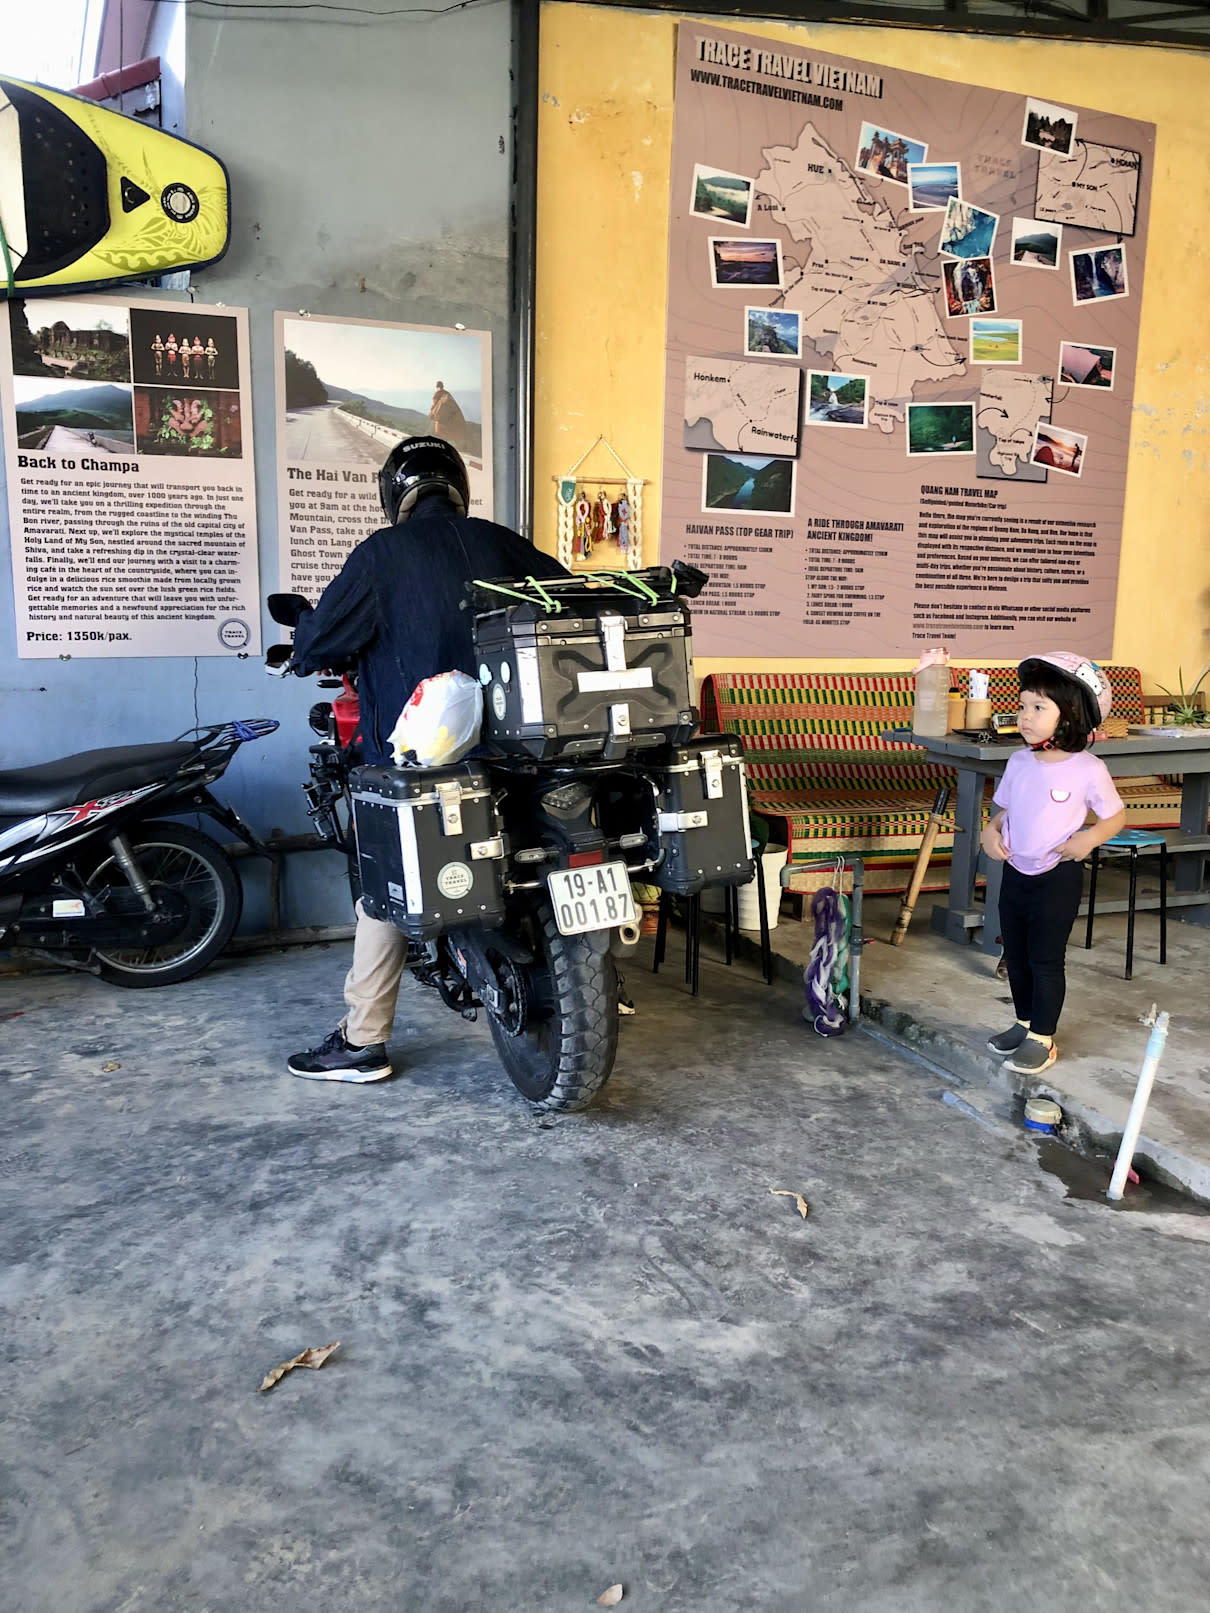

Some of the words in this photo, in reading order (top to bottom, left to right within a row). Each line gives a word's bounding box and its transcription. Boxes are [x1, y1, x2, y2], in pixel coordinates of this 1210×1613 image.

[695, 36, 750, 70] TRACE
[751, 48, 812, 83] TRAVEL
[810, 62, 883, 99] VIETNAM
[691, 69, 843, 111] WWW.TRACETRAVELVIETNAM.COM
[808, 164, 824, 173] HUE
[694, 372, 726, 384] Honkem
[403, 442, 445, 452] SUZUKI
[18, 456, 56, 469] Back
[61, 459, 76, 470] to
[81, 458, 139, 474] Champa
[287, 467, 312, 480] The
[316, 469, 338, 481] Hai
[342, 470, 368, 483] Van
[36, 479, 58, 487] ready
[103, 481, 132, 489] journey
[289, 488, 304, 497] Get
[306, 490, 332, 500] ready
[335, 491, 348, 499] for
[358, 492, 377, 500] wild
[921, 485, 943, 495] QUANG
[945, 487, 959, 496] NAM
[961, 488, 983, 498] TRAVEL
[984, 490, 998, 498] MAP
[114, 500, 143, 508] thrilling
[289, 502, 306, 510] you
[308, 502, 317, 510] at
[320, 502, 339, 510] 9am
[353, 504, 367, 512] the
[290, 513, 335, 524] Mountain,
[364, 516, 378, 524] the
[290, 525, 307, 533] Van
[310, 525, 334, 535] Pass,
[336, 527, 356, 535] take
[808, 518, 812, 527] A
[814, 518, 830, 528] RIDE
[832, 519, 864, 530] THROUGH
[866, 521, 904, 532] AMAVARATI
[686, 524, 714, 534] HAIVAN
[716, 526, 734, 536] PASS
[736, 527, 753, 536] (TOP
[754, 528, 773, 538] GEAR
[775, 529, 794, 539] TRIP)
[807, 530, 837, 540] ANCIENT
[838, 532, 873, 542] KINGDOM!
[290, 537, 315, 546] lunch
[331, 539, 351, 548] Lang
[93, 548, 132, 556] refreshing
[134, 548, 144, 556] dip
[291, 549, 316, 557] Ghost
[319, 550, 343, 558] Town
[291, 573, 312, 581] have
[292, 585, 314, 593] after
[27, 632, 62, 641] Price:
[68, 632, 132, 642] 1350k/pax.
[564, 868, 617, 899] 19-A1
[561, 893, 627, 928] 001.87
